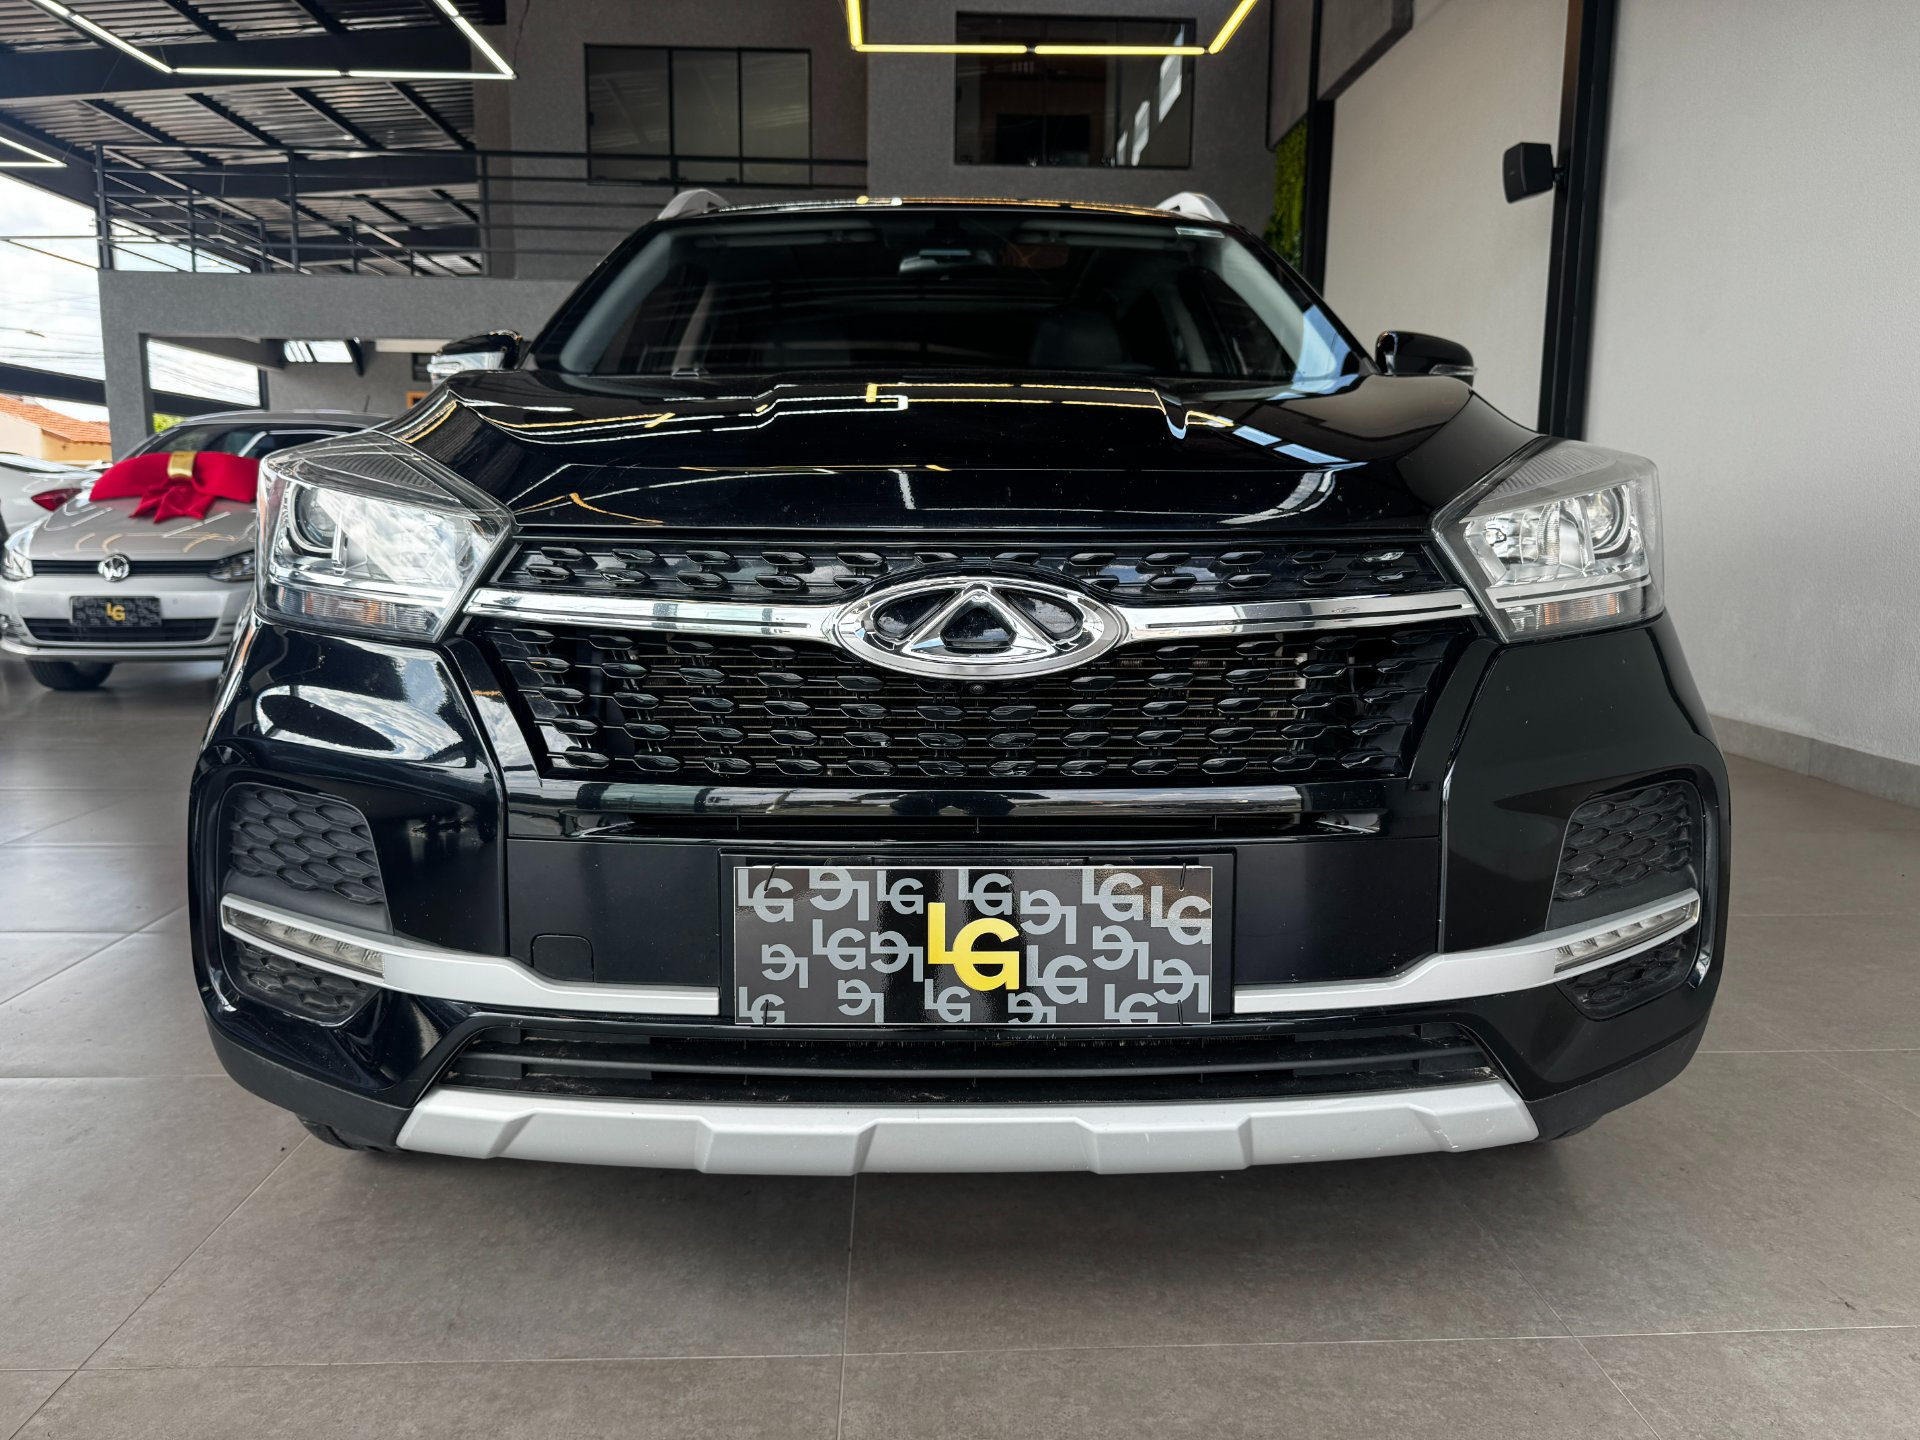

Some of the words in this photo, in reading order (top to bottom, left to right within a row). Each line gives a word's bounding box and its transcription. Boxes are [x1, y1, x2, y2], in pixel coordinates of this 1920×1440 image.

[105, 602, 126, 621] LG
[738, 869, 794, 922] LG
[877, 870, 924, 914] LG
[958, 869, 1012, 916] LG
[1082, 868, 1144, 922] LG
[1150, 886, 1211, 945] LG
[812, 919, 866, 970] LG
[928, 902, 1020, 991] LG
[924, 978, 971, 1022] LG
[1026, 944, 1088, 1005] LG
